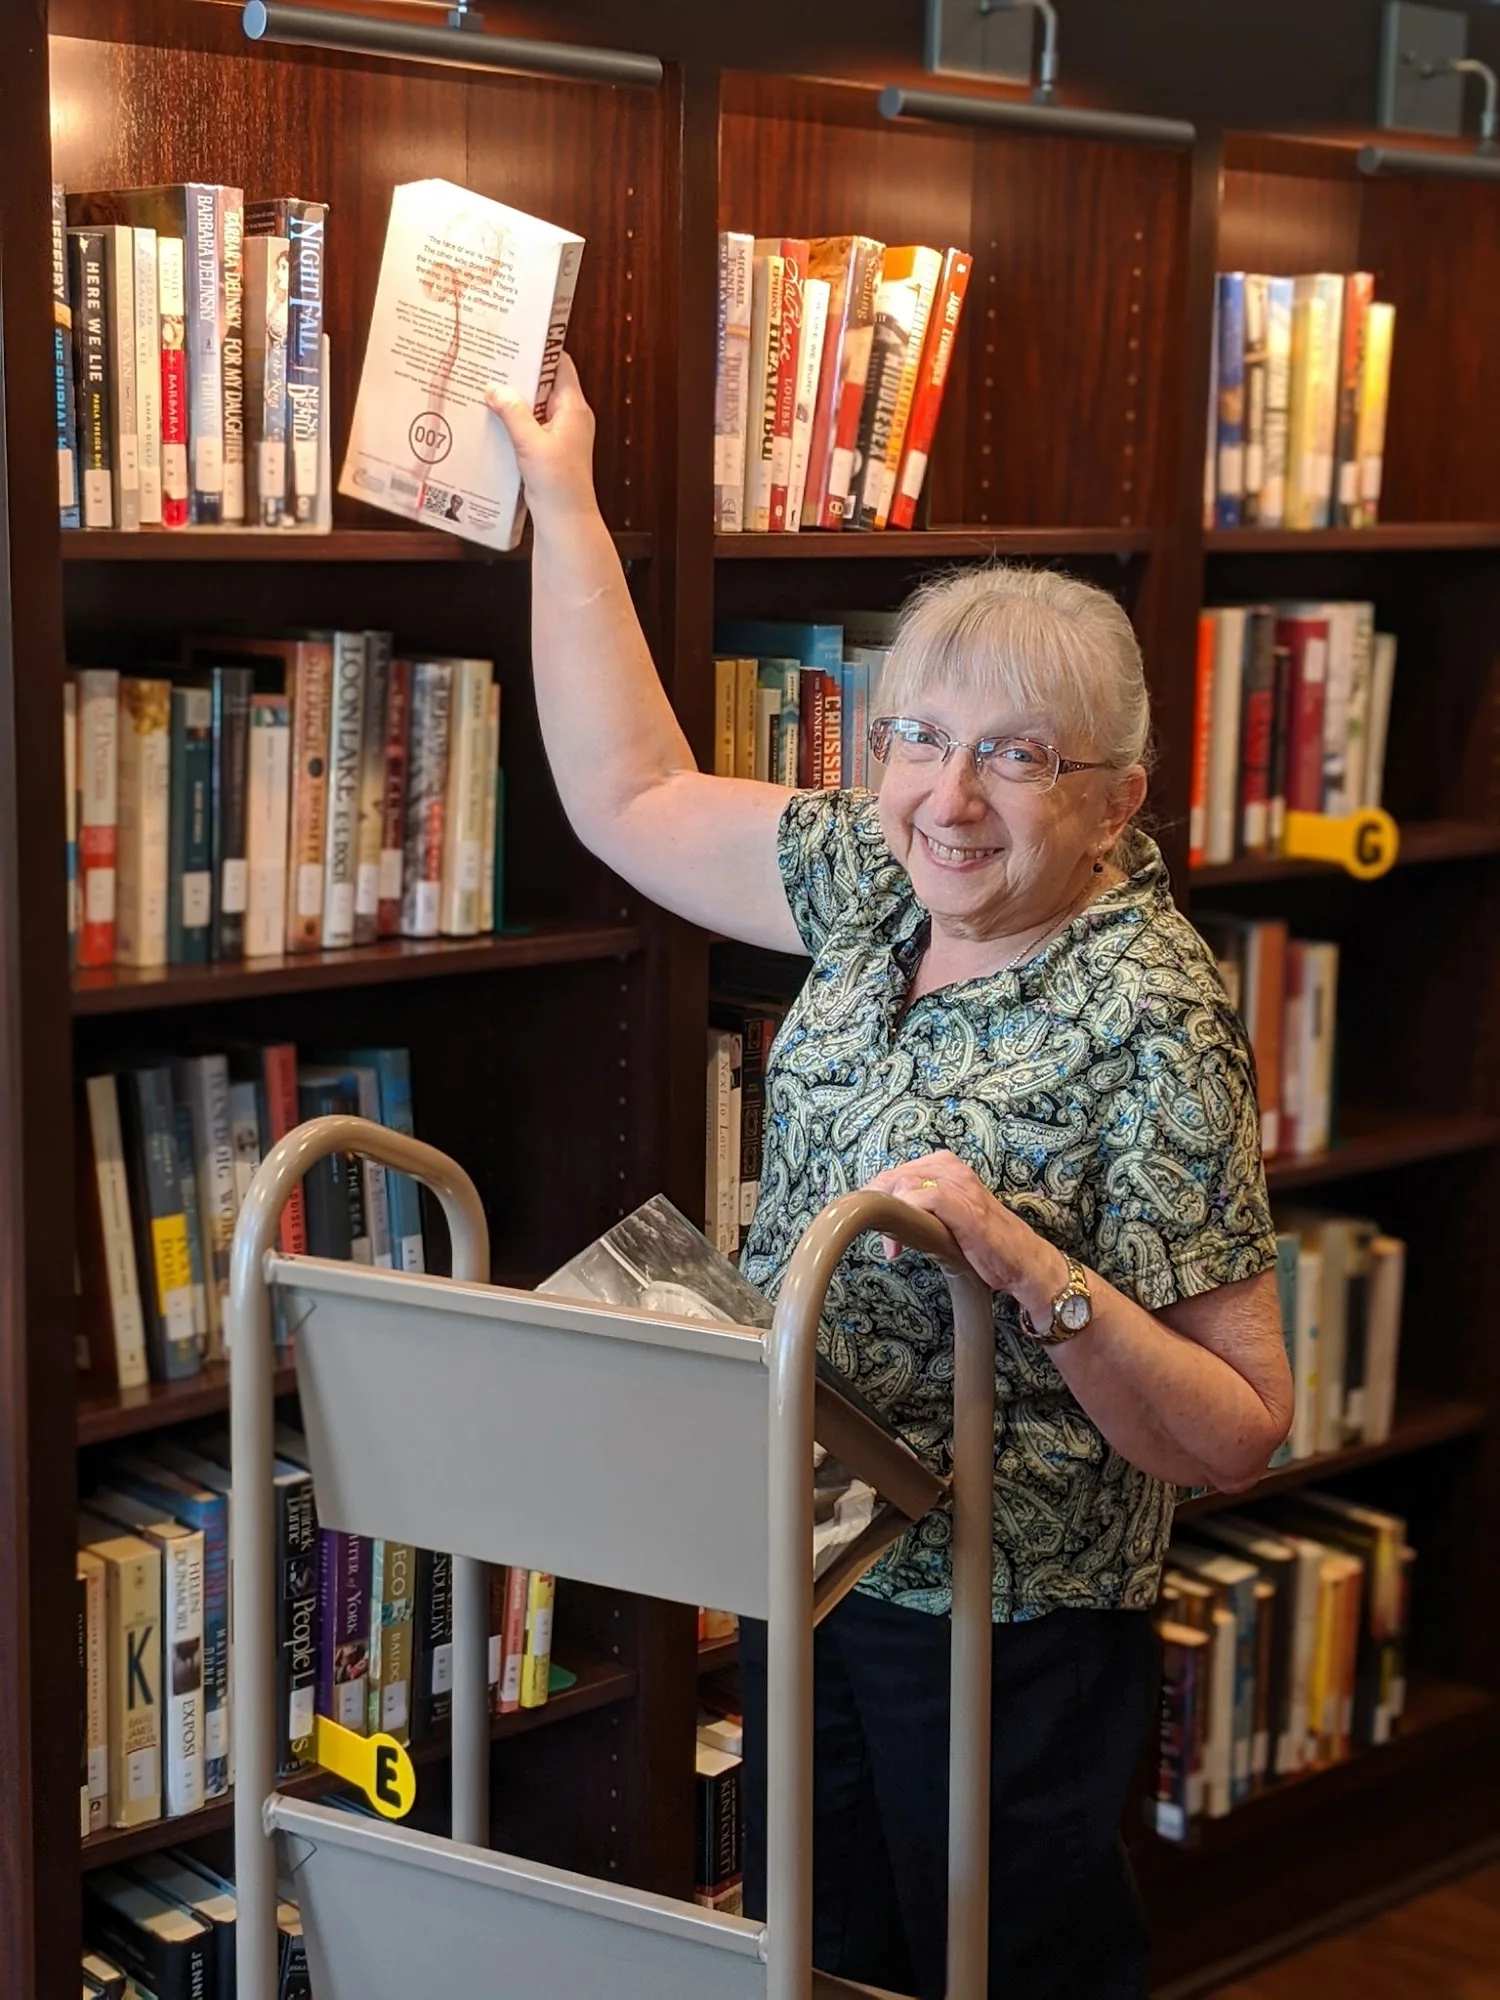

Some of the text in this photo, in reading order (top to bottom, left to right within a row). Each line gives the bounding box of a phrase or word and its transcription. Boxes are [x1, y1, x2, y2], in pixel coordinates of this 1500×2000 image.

[197, 195, 216, 323] BARBARA DELINSKY
[289, 216, 324, 357] NIGHT FALL
[736, 249, 746, 308] MICHAEL
[87, 262, 102, 382] HERE WE LIE
[223, 211, 242, 464] BARBARA DELINSKY FOR MY DAUGHTER
[538, 323, 567, 391] CARTE
[762, 265, 781, 461] EPHRON HEARTBU
[308, 385, 320, 440] NELSO
[782, 378, 793, 427] LOUISE
[869, 351, 903, 458] MIDDLESEX
[415, 426, 447, 448] 007
[336, 645, 362, 803] LOON LAKE
[822, 695, 842, 790] CROSSB
[1356, 821, 1382, 867] G
[348, 1164, 362, 1238] THE SEA
[286, 1498, 301, 1545] Dunne
[300, 1485, 316, 1551] Dominick
[391, 1548, 407, 1596] ECO
[430, 1552, 447, 1640] ENDULUM
[283, 1597, 317, 1669] People
[346, 1590, 362, 1635] YORK
[127, 1626, 154, 1712] K
[390, 1632, 401, 1682] BAUDO
[183, 1700, 196, 1759] EXPOS
[376, 1745, 402, 1809] E
[191, 1951, 204, 2000] JENN
